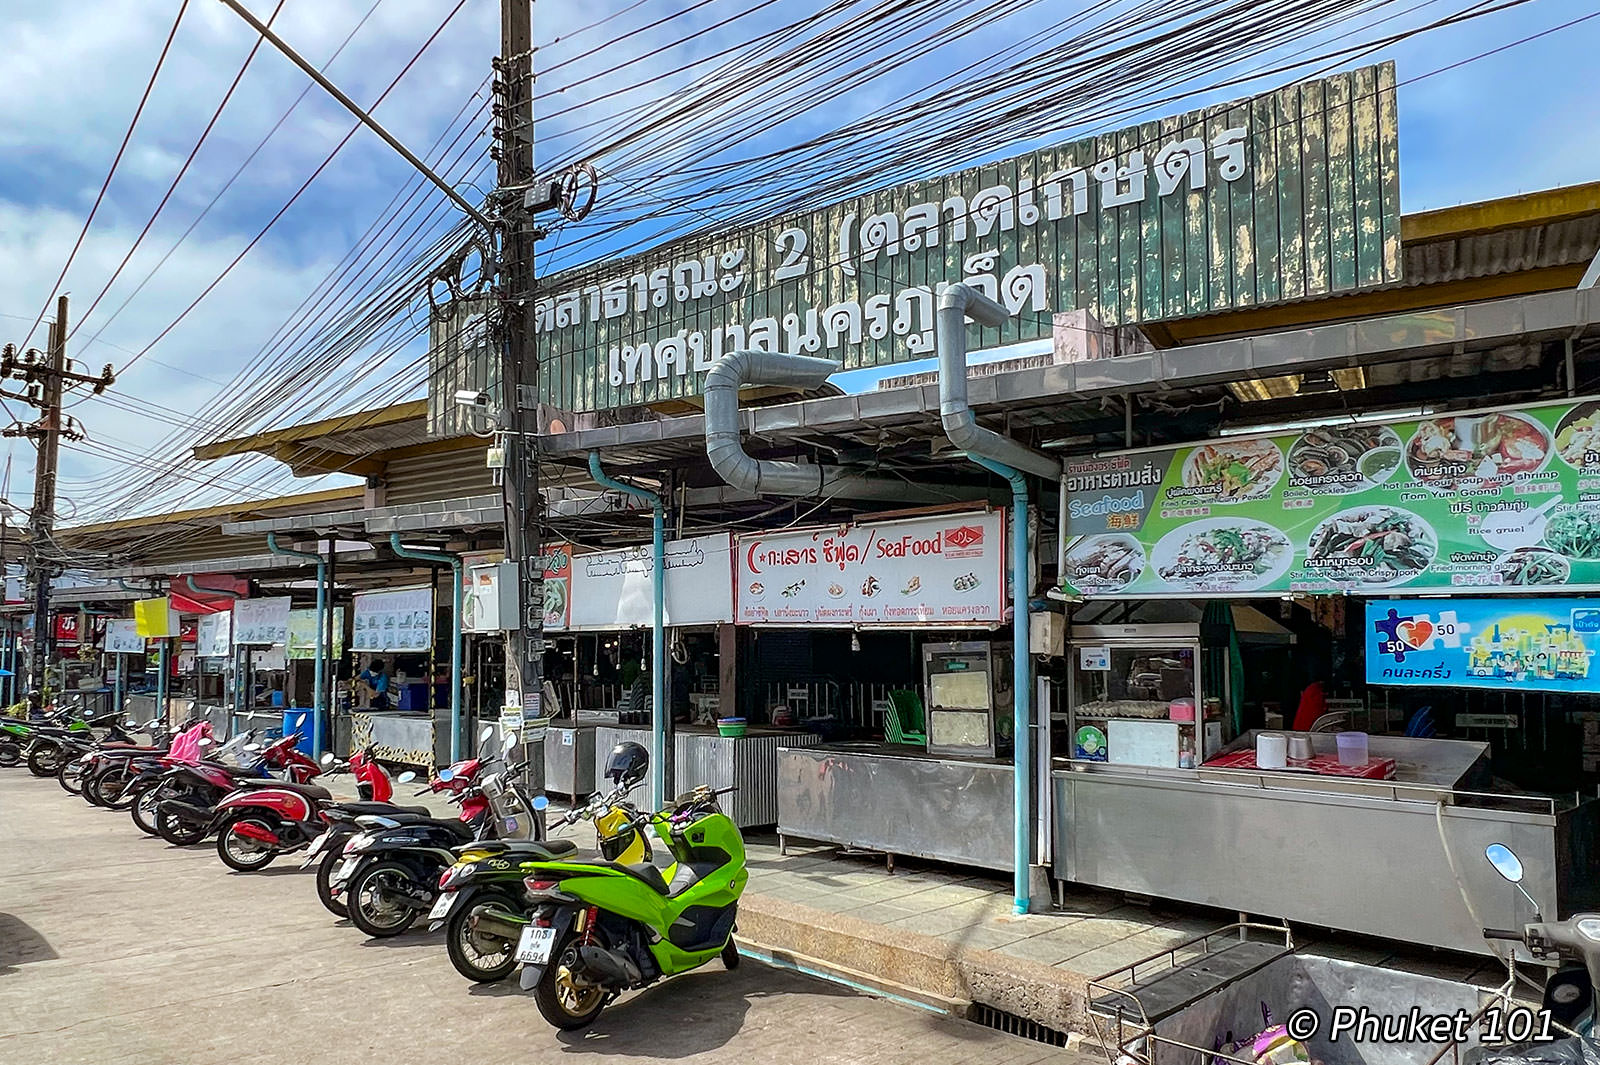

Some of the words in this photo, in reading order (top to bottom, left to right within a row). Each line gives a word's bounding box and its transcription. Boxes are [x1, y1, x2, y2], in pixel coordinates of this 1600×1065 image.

[775, 227, 809, 281] 2
[1068, 462, 1162, 491] อาหารตามสั่ง
[1456, 477, 1484, 485] soup
[1488, 474, 1512, 482] with
[1517, 471, 1559, 480] shrimp
[1400, 493, 1427, 502] (Tom
[1431, 490, 1455, 498] Yum
[1460, 487, 1501, 497] Goong)
[1068, 490, 1144, 518] Seafood
[1496, 526, 1525, 535] gruel
[1399, 568, 1419, 576] pork
[1455, 563, 1492, 571] morning
[1437, 624, 1454, 635] 50
[1387, 641, 1405, 652] 50
[1382, 662, 1451, 679] คนละครึ่ง
